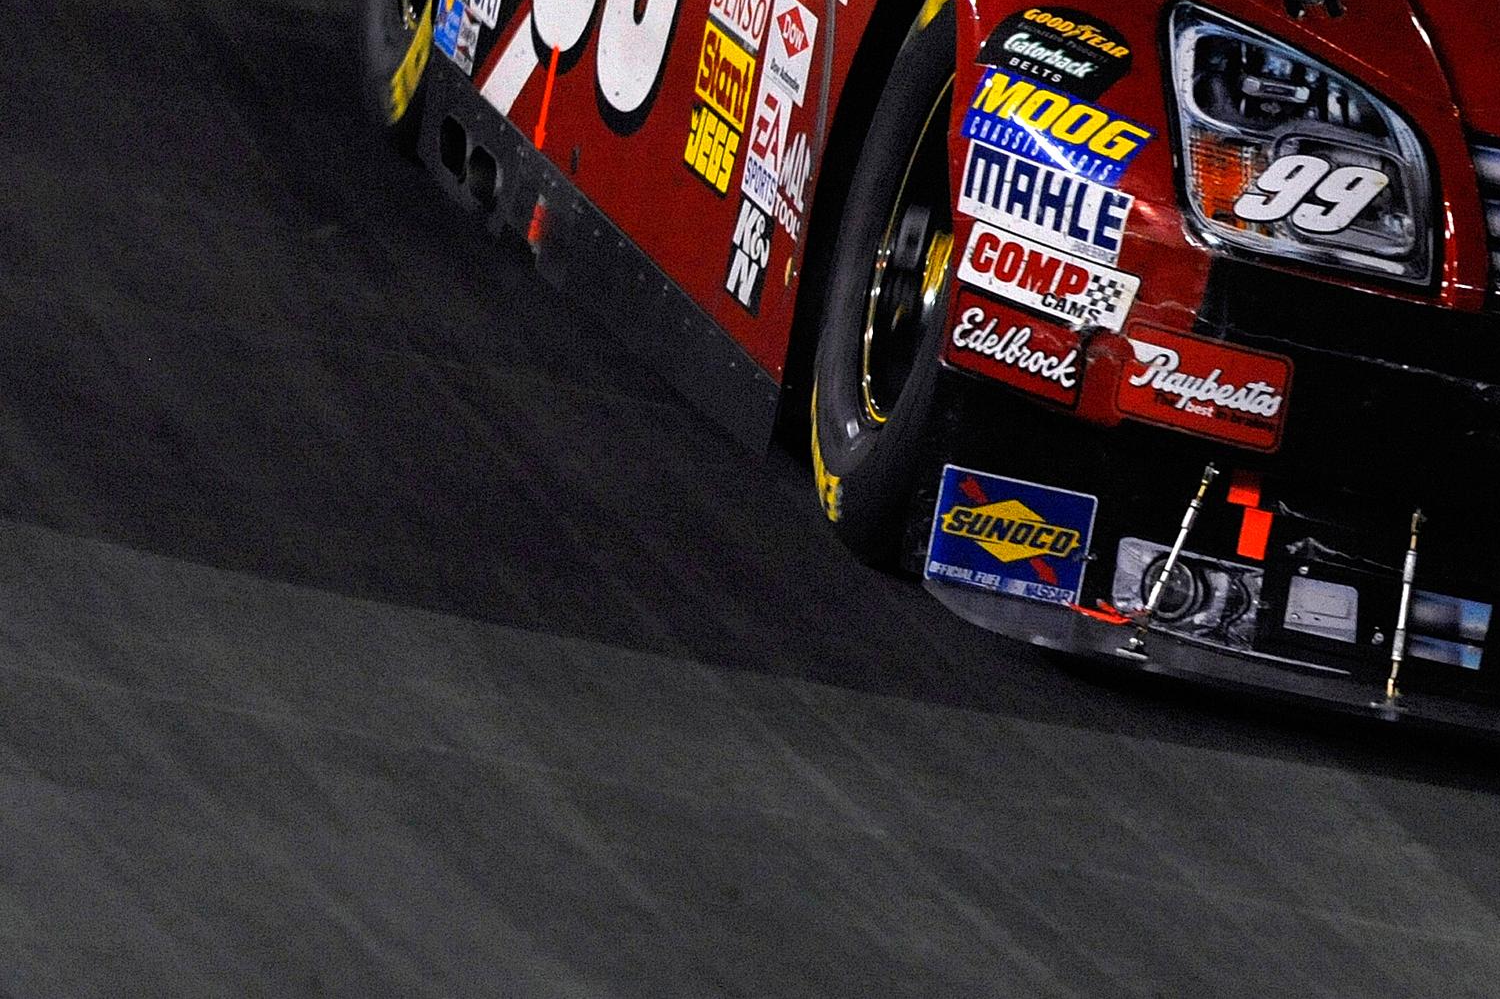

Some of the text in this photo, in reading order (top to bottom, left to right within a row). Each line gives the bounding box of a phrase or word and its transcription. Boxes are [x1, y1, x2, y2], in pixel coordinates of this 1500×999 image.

[1003, 32, 1094, 78] Gatorback
[1009, 57, 1063, 83] BELTS
[1023, 8, 1130, 59] GOODYEAR
[700, 29, 750, 119] Stant
[684, 105, 740, 193] JEGS
[751, 93, 782, 173] EA
[973, 73, 1151, 161] MOOG
[744, 156, 776, 207] SPORTS
[964, 142, 1131, 252] MAHLE
[1234, 154, 1389, 235] 99
[726, 199, 770, 306] K&N
[971, 232, 1090, 298] COMP
[1041, 293, 1102, 322] CAMS
[953, 307, 1078, 387] Edelbrock
[1127, 338, 1283, 418] Raybestos
[1186, 401, 1215, 417] best
[945, 508, 1074, 552] SUNOCO
[928, 560, 974, 579] OFFICIAL
[975, 571, 1002, 586] FUEL
